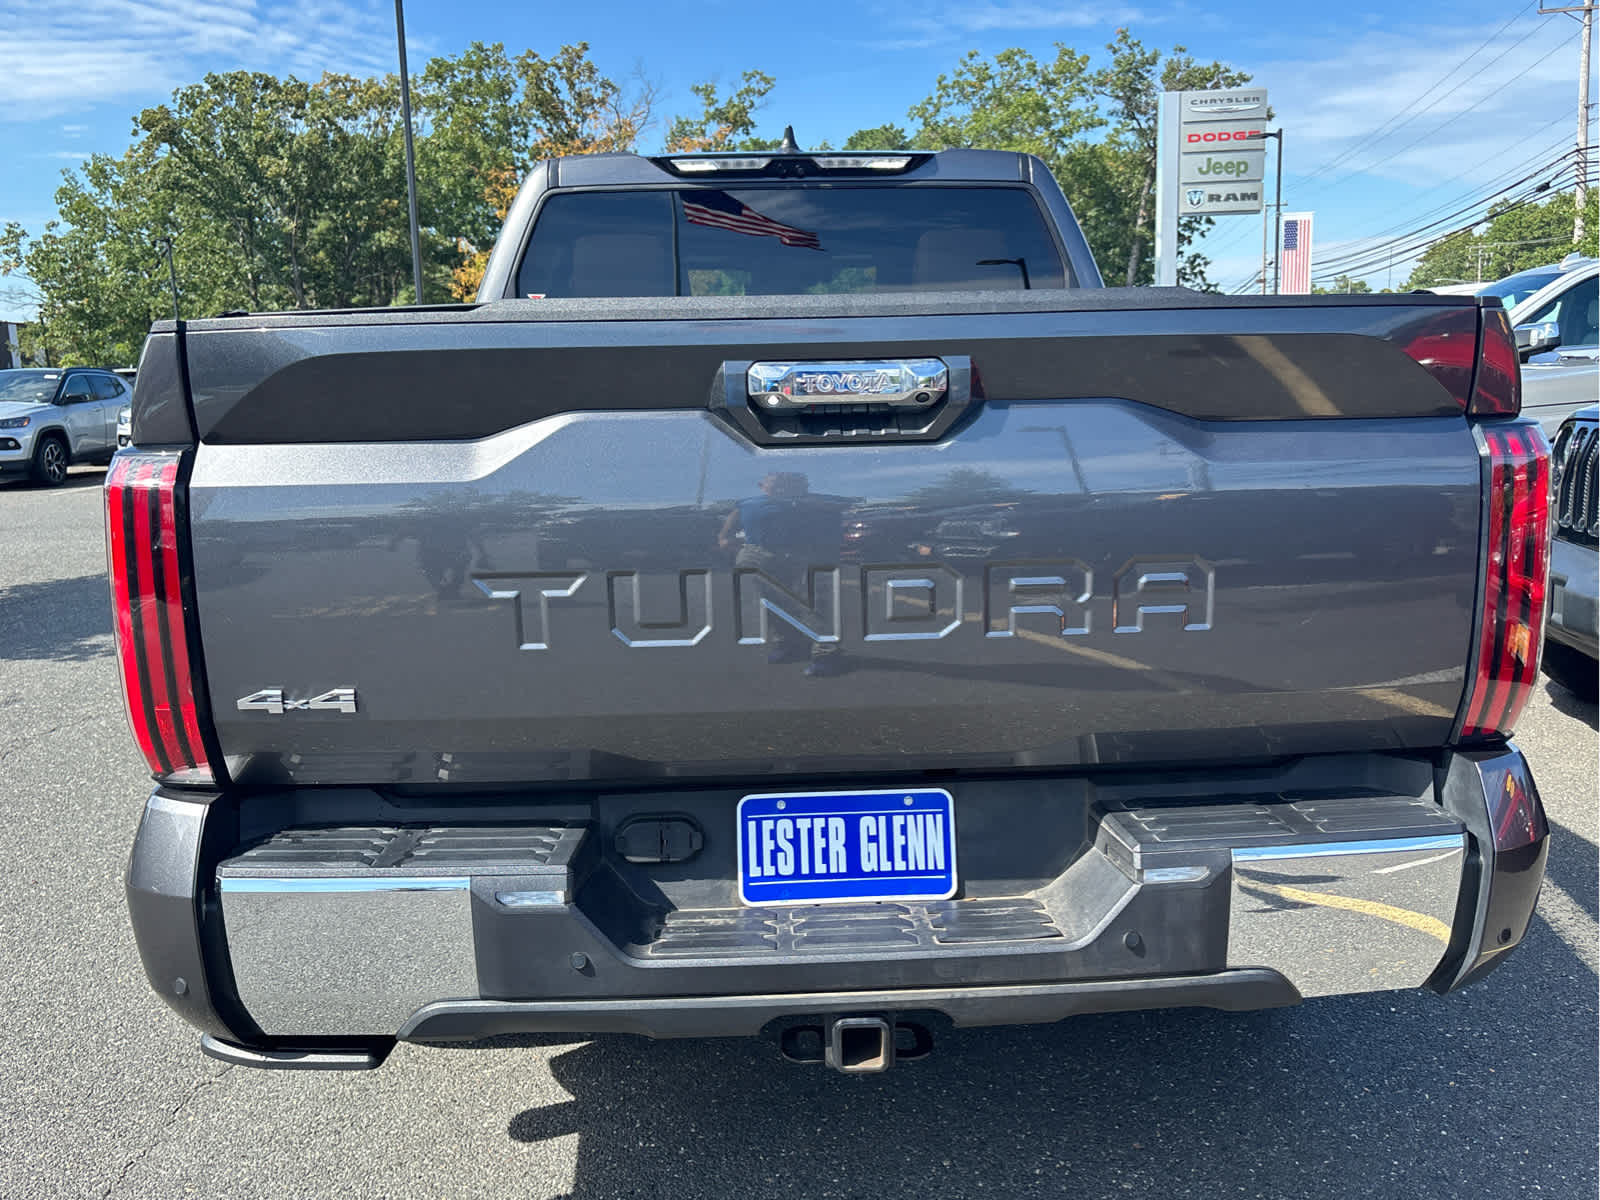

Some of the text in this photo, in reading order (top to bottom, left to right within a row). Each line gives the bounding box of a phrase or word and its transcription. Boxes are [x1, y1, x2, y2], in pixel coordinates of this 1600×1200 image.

[1190, 96, 1260, 105] CHRYSLER
[1197, 157, 1249, 178] Jeep
[1207, 192, 1258, 203] RAM
[801, 372, 893, 394] TOYOTA
[471, 555, 1215, 650] TUNDRA
[747, 813, 945, 878] LESTER GLENN
